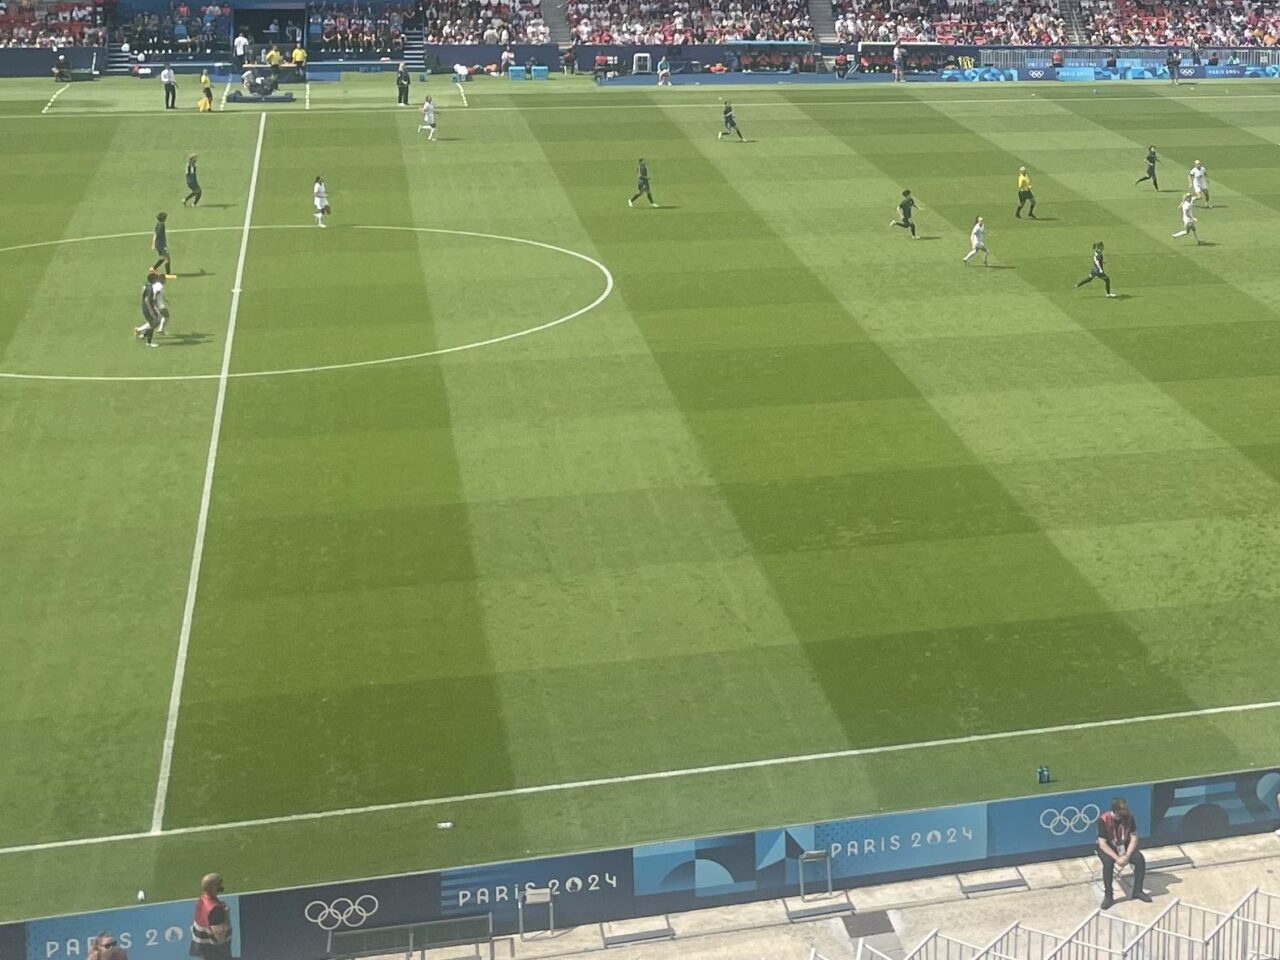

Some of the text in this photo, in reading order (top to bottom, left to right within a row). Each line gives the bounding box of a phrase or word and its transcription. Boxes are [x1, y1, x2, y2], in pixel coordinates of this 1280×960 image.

[831, 826, 973, 858] PARIS 2024
[548, 872, 617, 895] 2024
